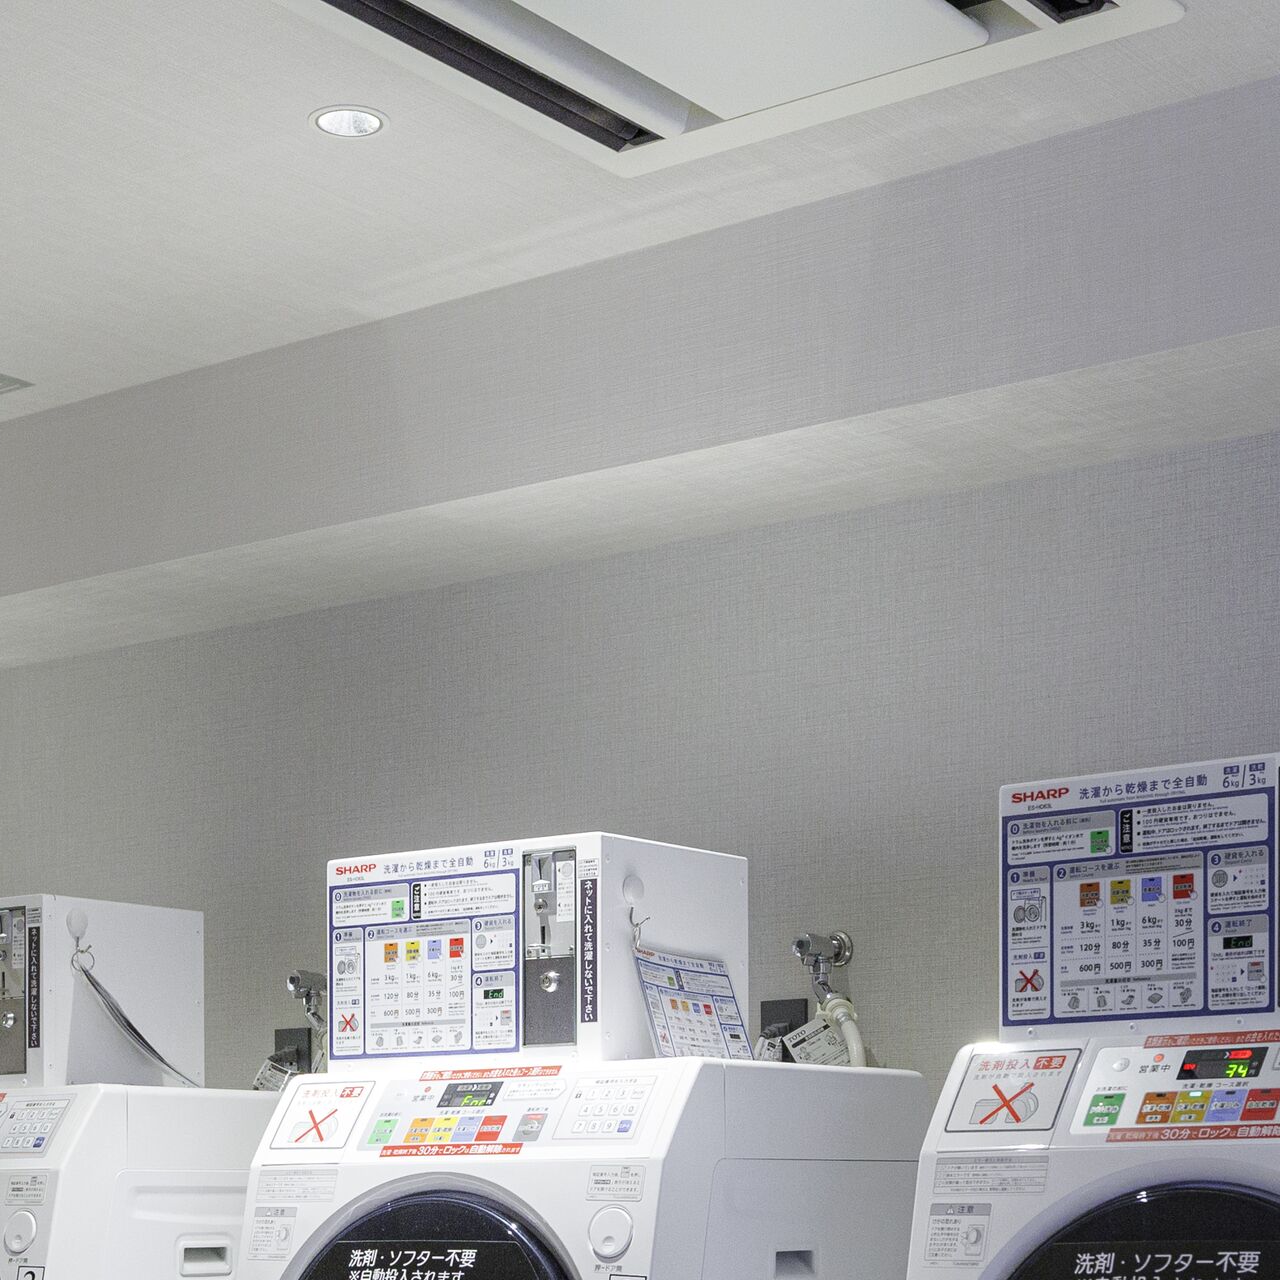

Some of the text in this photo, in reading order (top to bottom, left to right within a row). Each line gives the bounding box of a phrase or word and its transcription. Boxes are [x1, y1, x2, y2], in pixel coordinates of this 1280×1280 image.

[1079, 774, 1208, 800] 洗濯から乾燥まで全自動
[1011, 787, 1070, 804] SHARP
[335, 863, 377, 876] SHARP
[583, 880, 595, 1021] ネットに入れて洗濯しないで下さい
[1079, 963, 1101, 973] 600円
[1110, 961, 1132, 971] 500円
[1141, 959, 1163, 968] 300円
[788, 1029, 806, 1043] TOTO
[978, 1057, 1066, 1071] 洗剤投入 不要
[1139, 1064, 1171, 1073] 営業中
[348, 1249, 477, 1268] 洗剤・ソフター不要
[1074, 1251, 1261, 1274] 洗剤・ソフター不要
